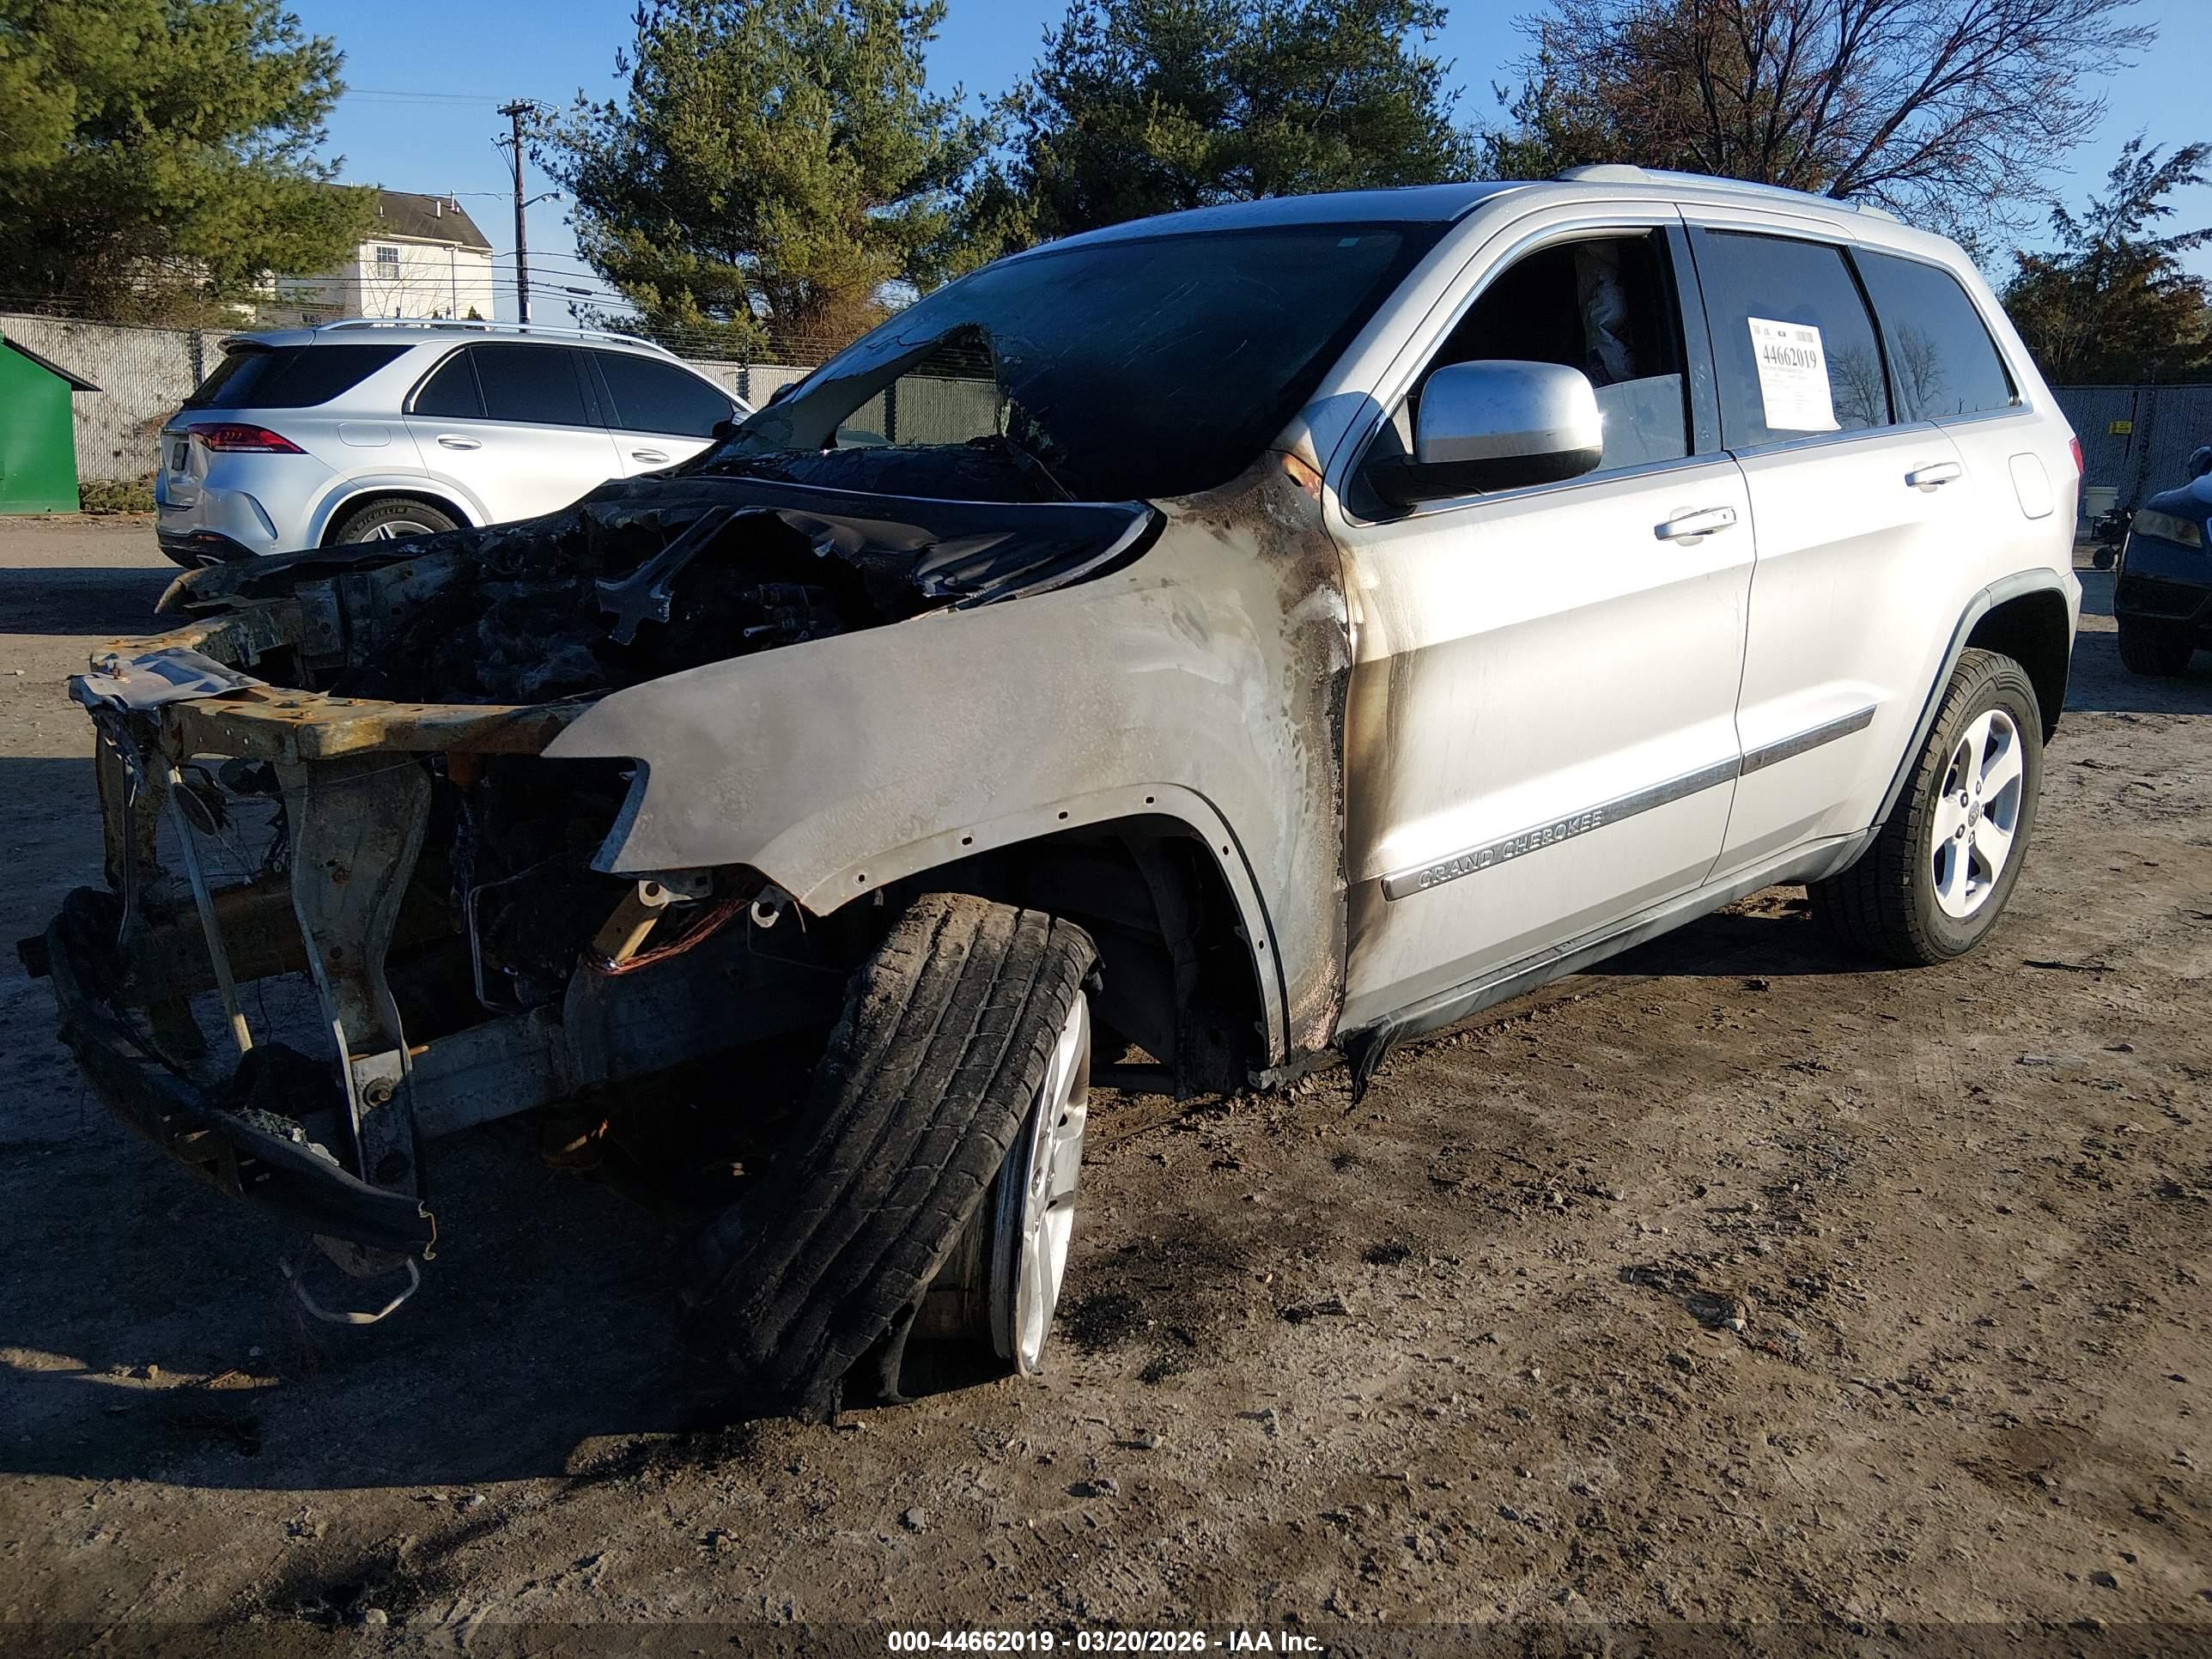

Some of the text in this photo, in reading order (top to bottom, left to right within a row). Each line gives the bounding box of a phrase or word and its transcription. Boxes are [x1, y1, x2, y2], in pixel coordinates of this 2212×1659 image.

[1763, 343, 1817, 369] 44662019
[1418, 810, 1604, 888] GRAND CHEROKEE
